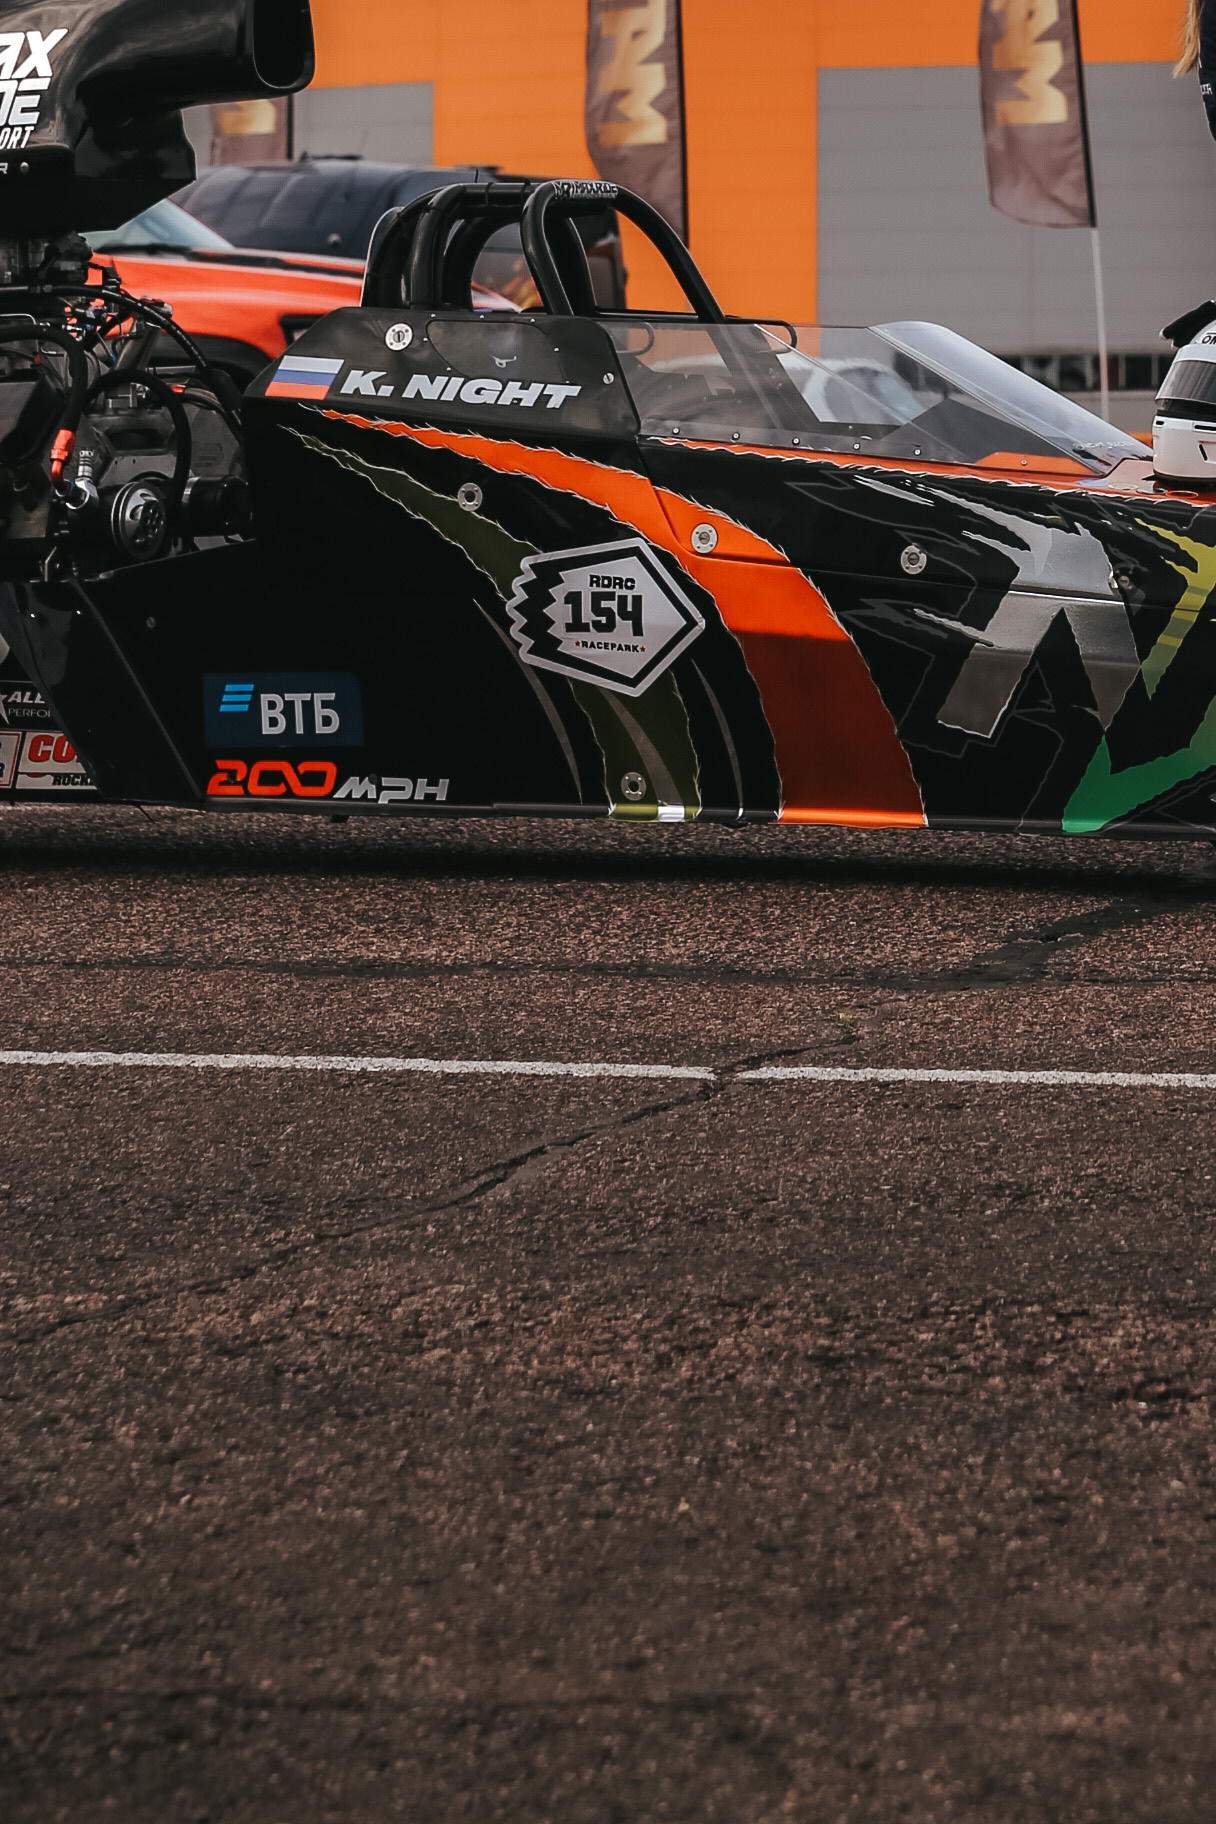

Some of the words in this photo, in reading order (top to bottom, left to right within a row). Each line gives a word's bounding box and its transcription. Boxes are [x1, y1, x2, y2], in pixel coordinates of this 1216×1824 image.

[340, 370, 395, 397] K.
[402, 374, 582, 409] NIGHT
[589, 574, 636, 590] RDRC
[563, 590, 644, 637] 154
[581, 640, 640, 653] RACEPARK
[260, 692, 340, 735] ВТБ
[28, 734, 80, 764] CO
